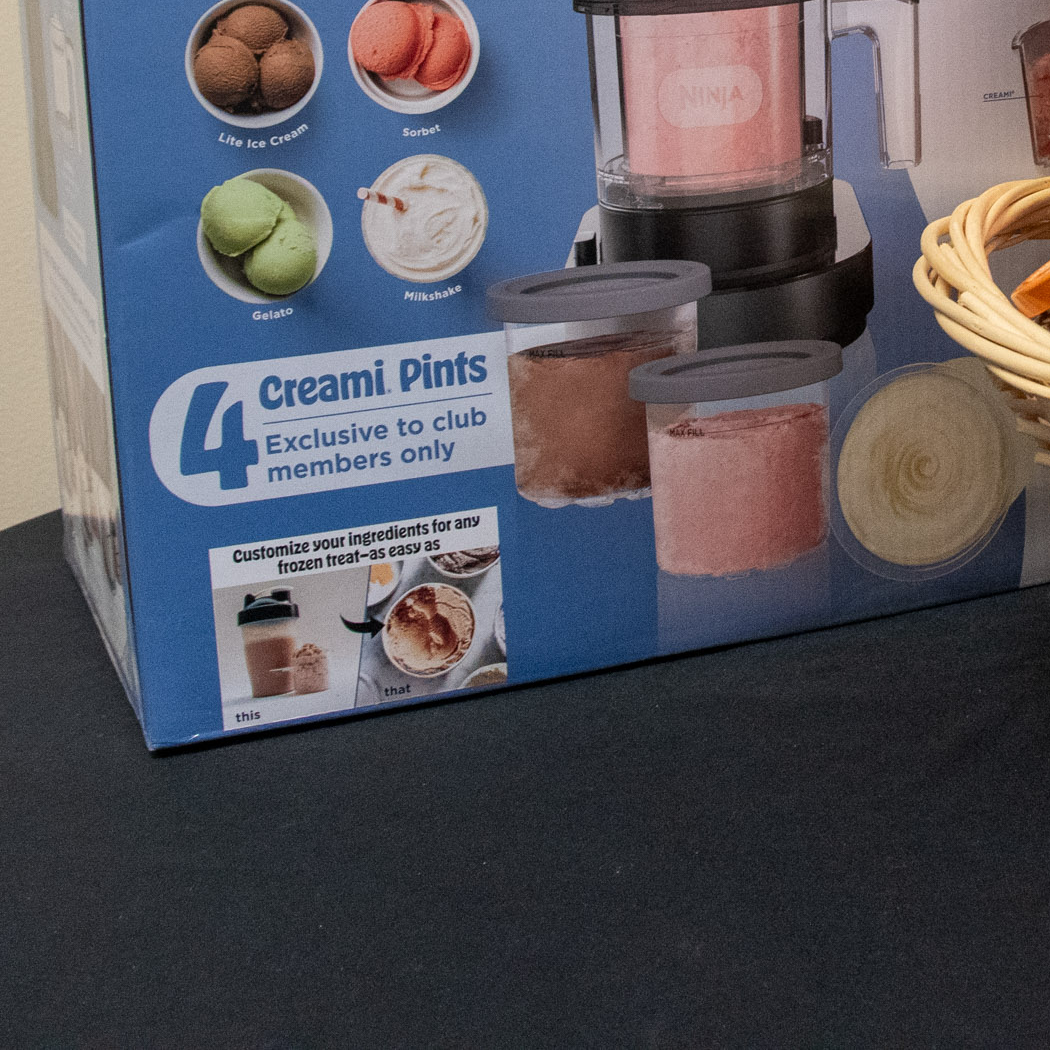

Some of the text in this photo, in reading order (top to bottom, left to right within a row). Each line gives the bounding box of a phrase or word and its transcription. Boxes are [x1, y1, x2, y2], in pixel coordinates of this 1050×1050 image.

[680, 84, 746, 111] NINJA
[217, 123, 308, 149] Lite Ice Cream
[402, 124, 441, 138] Sorbet
[404, 283, 462, 301] Milkshake
[251, 306, 294, 321] Gelato
[529, 350, 565, 358] MAX FILL
[258, 351, 488, 410] Creami Pints
[179, 380, 259, 491] 4
[265, 407, 488, 455] Exclusive to club
[669, 428, 705, 437] MAX FILL
[267, 440, 455, 483] members only
[232, 516, 480, 564] Customize your ingredients for any
[278, 560, 323, 575] frozen
[389, 542, 422, 557] easy
[424, 539, 440, 551] as
[384, 683, 411, 697] that
[235, 708, 261, 724] this
